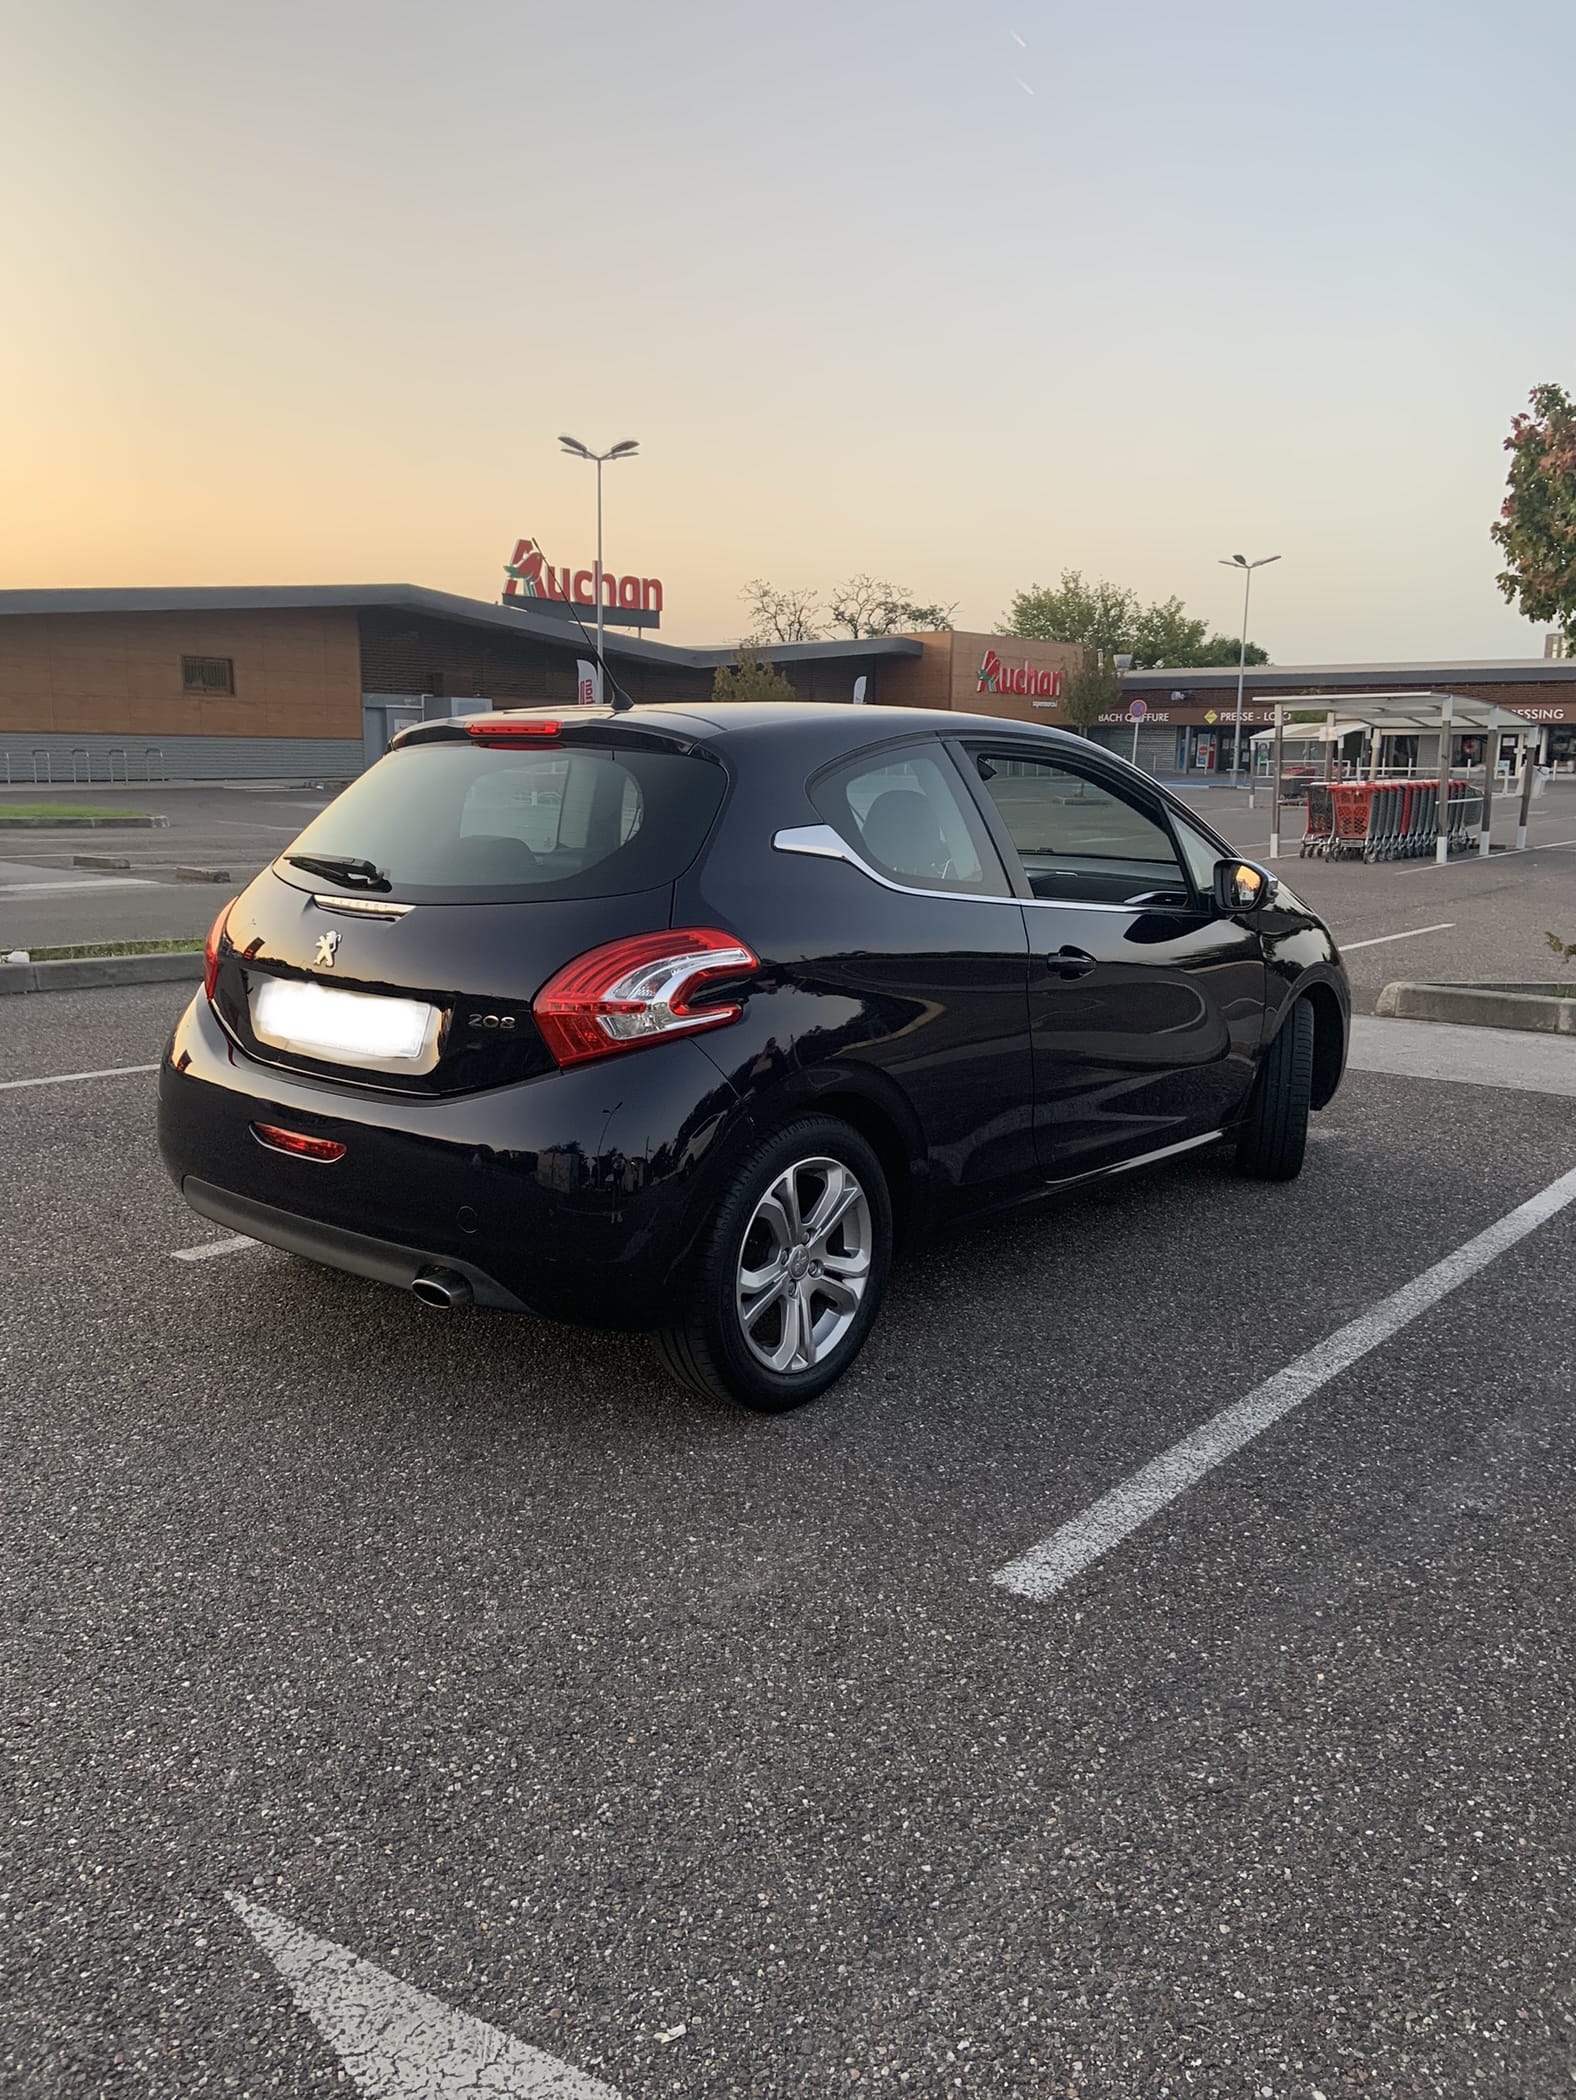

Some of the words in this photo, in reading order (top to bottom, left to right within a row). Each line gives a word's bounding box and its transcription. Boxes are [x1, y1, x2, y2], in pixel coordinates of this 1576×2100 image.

[503, 538, 663, 612] Auchan
[977, 649, 1063, 697] Auchan
[1124, 712, 1169, 722] CFFURE
[1263, 711, 1292, 721] LOO
[467, 1013, 516, 1029] 208
